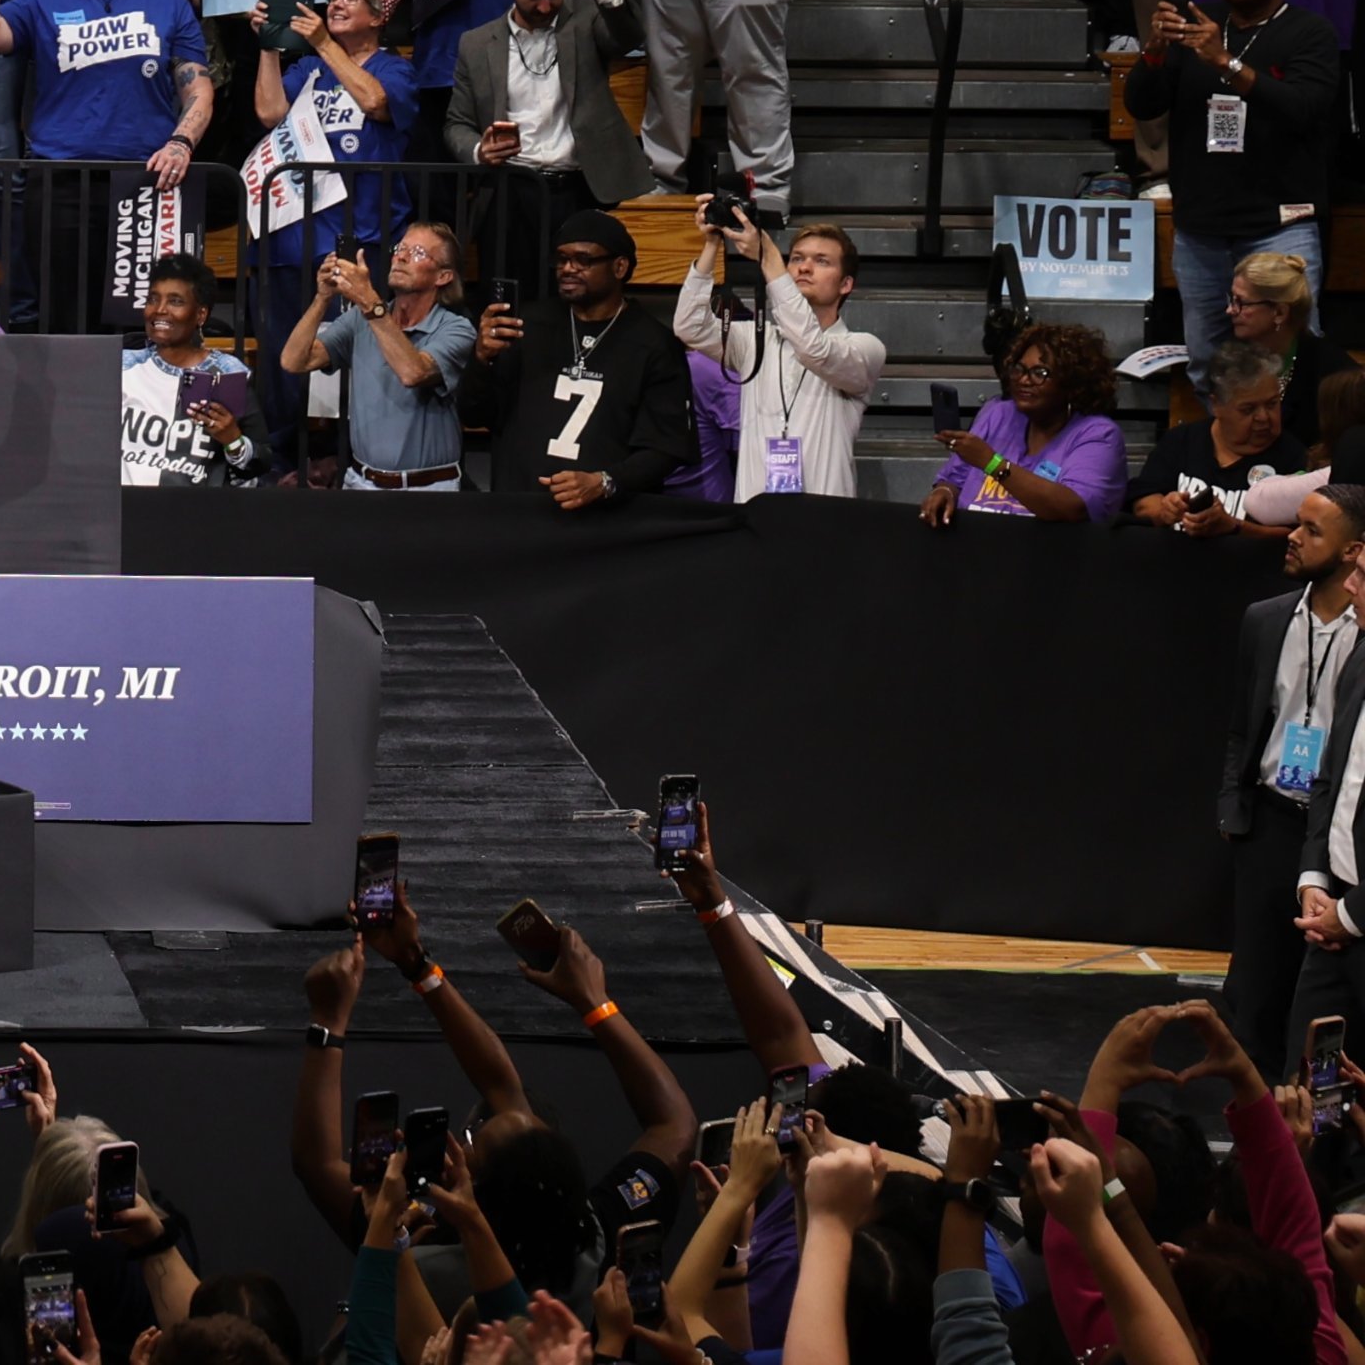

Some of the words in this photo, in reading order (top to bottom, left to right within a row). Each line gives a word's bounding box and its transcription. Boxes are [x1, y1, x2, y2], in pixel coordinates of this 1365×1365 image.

[78, 14, 130, 41] UAW
[69, 32, 150, 62] POWER
[110, 197, 134, 298] MOVING
[132, 185, 154, 310] MICHIGAN
[1016, 202, 1132, 263] VOTE
[1038, 261, 1119, 276] NOVEMBER
[547, 374, 604, 460] 7
[770, 453, 798, 465] STAFF
[115, 666, 181, 700] MI
[1292, 744, 1309, 757] AA
